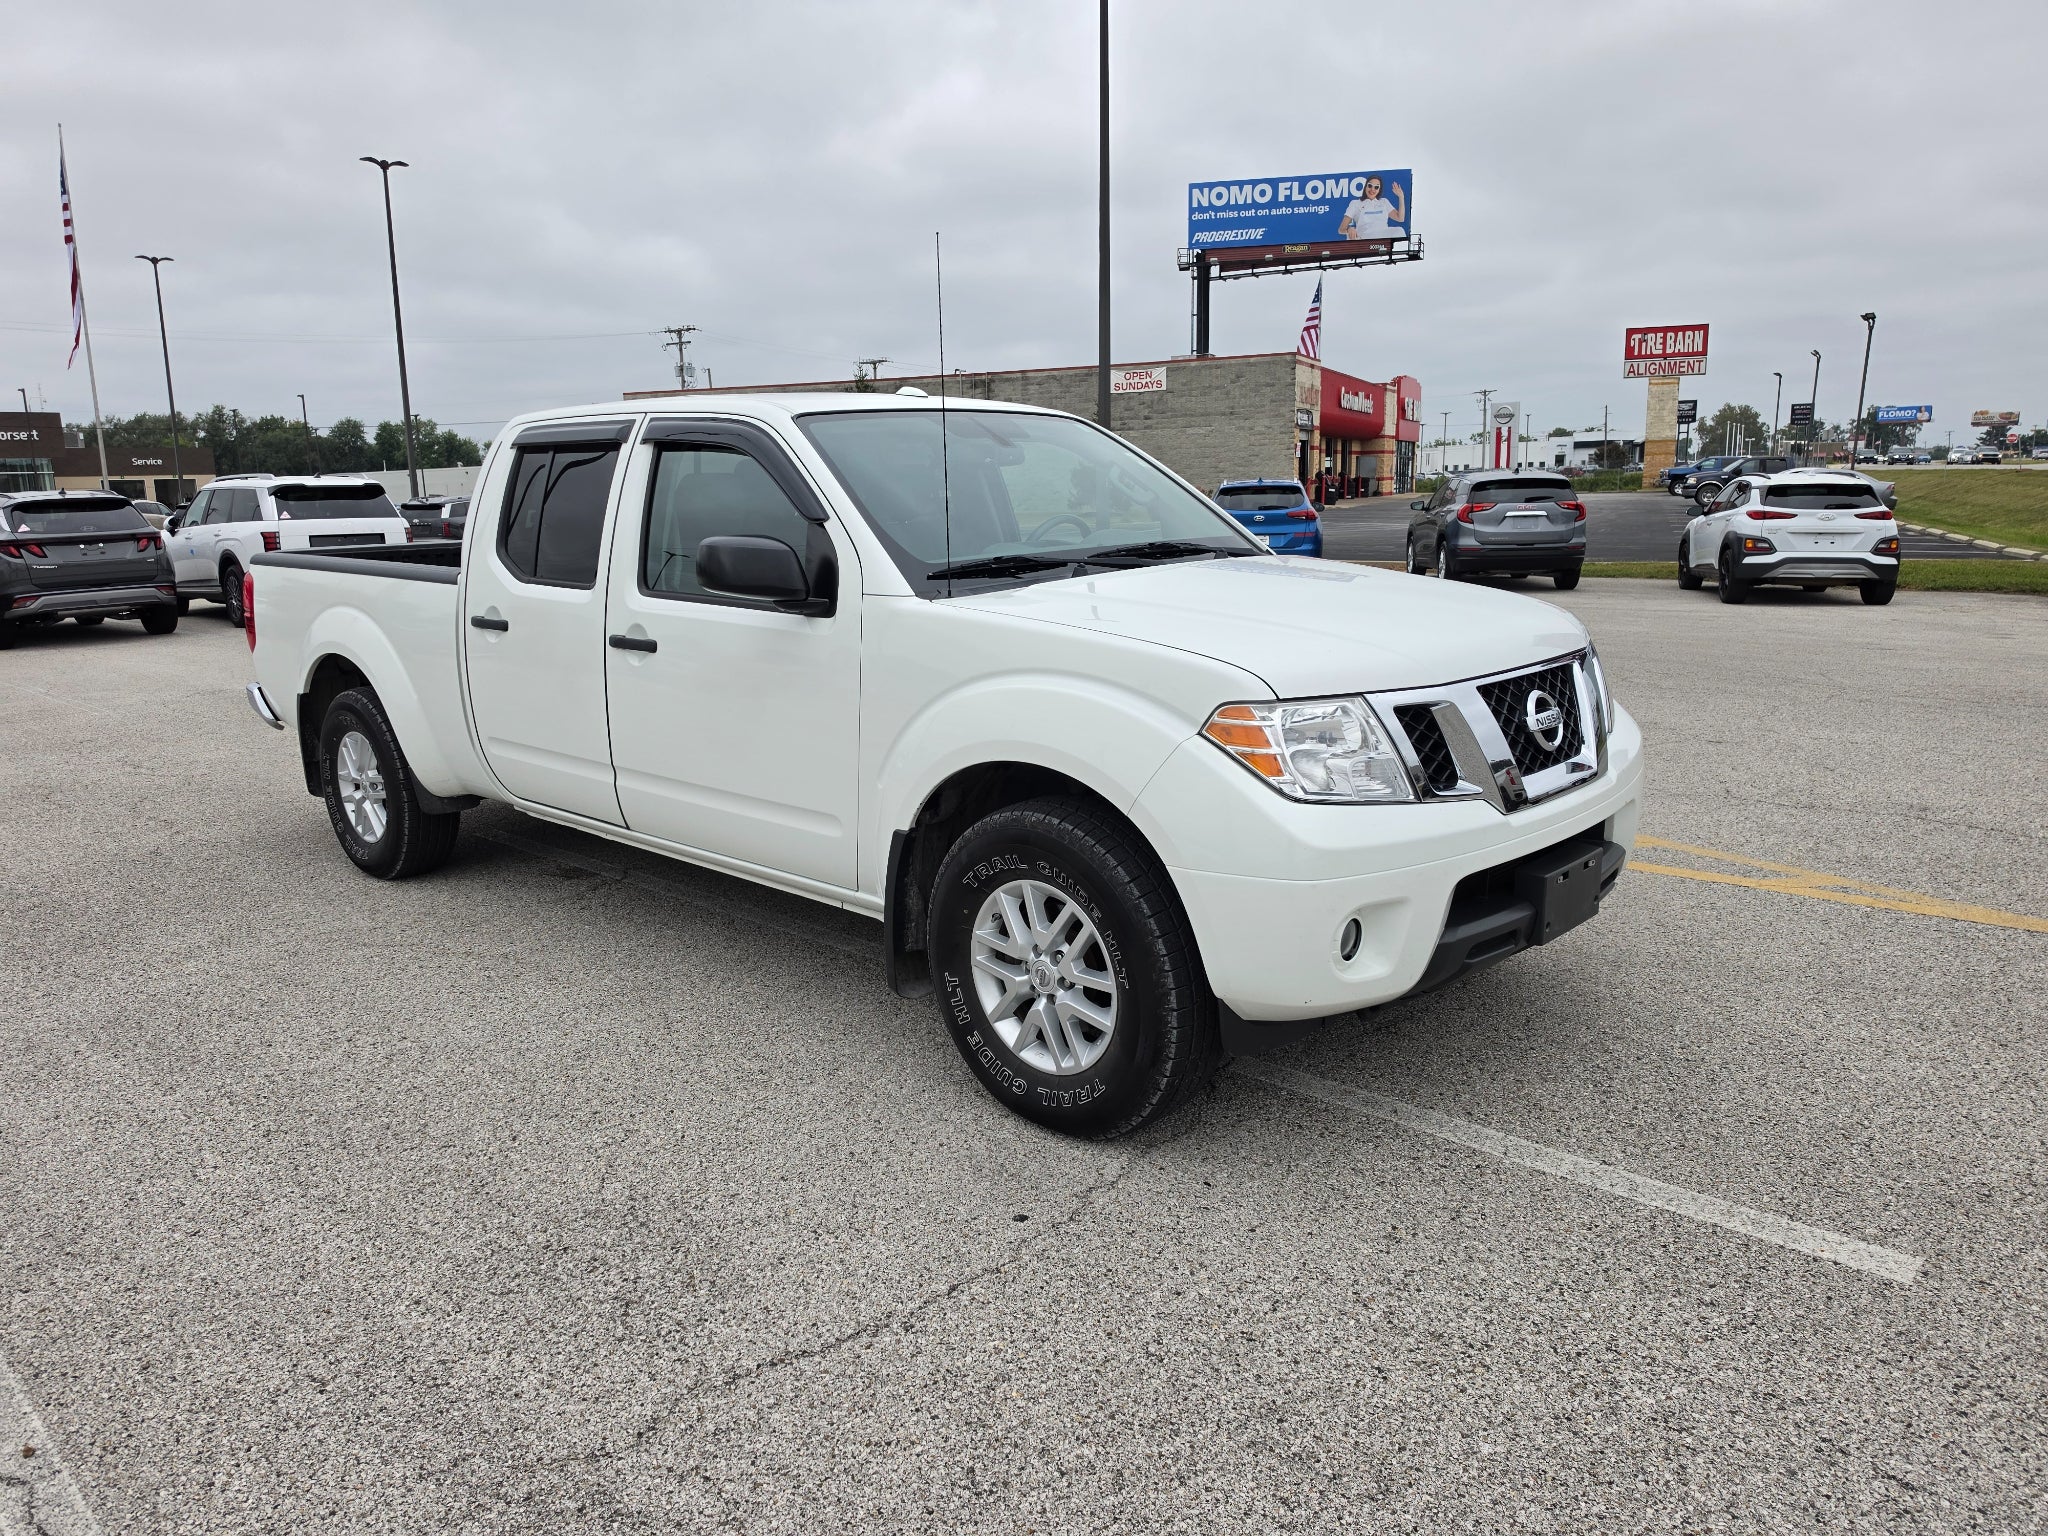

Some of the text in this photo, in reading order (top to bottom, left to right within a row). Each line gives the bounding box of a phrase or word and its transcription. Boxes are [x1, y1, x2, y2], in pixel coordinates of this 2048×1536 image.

[1192, 177, 1367, 207] NOMO FLOMO
[1192, 204, 1330, 220] don't miss out on auto savings
[1192, 228, 1265, 243] PROGRESSIVE
[1666, 330, 1704, 354] BARN
[1124, 371, 1153, 380] OPEN
[1627, 360, 1704, 376] ALIGNMENT
[1114, 380, 1163, 391] SUNDAYS
[1878, 410, 1917, 418] FLOMO?
[0, 429, 40, 440] orset
[132, 458, 163, 466] Service
[963, 855, 1129, 989] TRAIL GUIDE HLT
[944, 972, 1106, 1107] TRAIL GUIDE HLT
